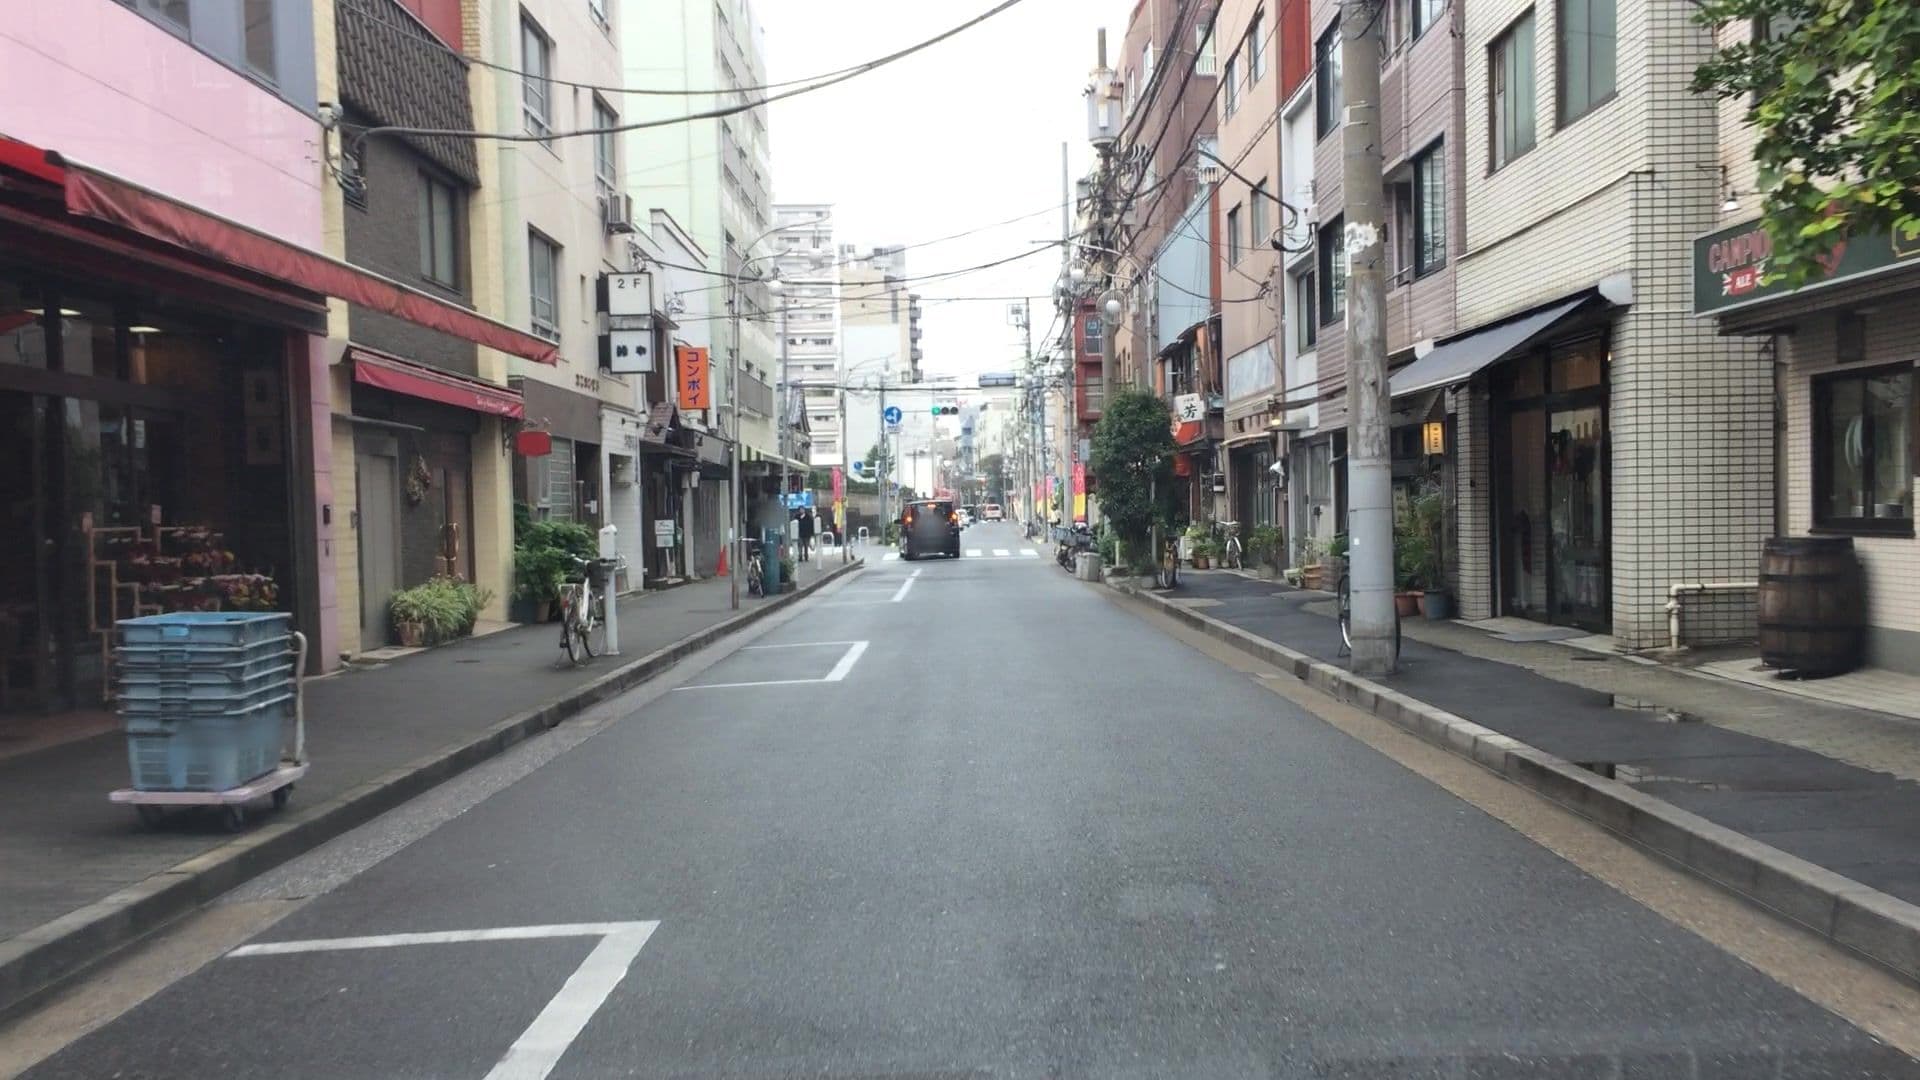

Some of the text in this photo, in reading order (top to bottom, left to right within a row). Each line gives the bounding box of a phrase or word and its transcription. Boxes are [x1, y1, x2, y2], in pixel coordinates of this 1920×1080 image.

[1709, 229, 1773, 273] CAMPIO
[1735, 274, 1752, 288] ALE
[687, 350, 701, 405] コンボイ
[1184, 403, 1198, 418] 芳
